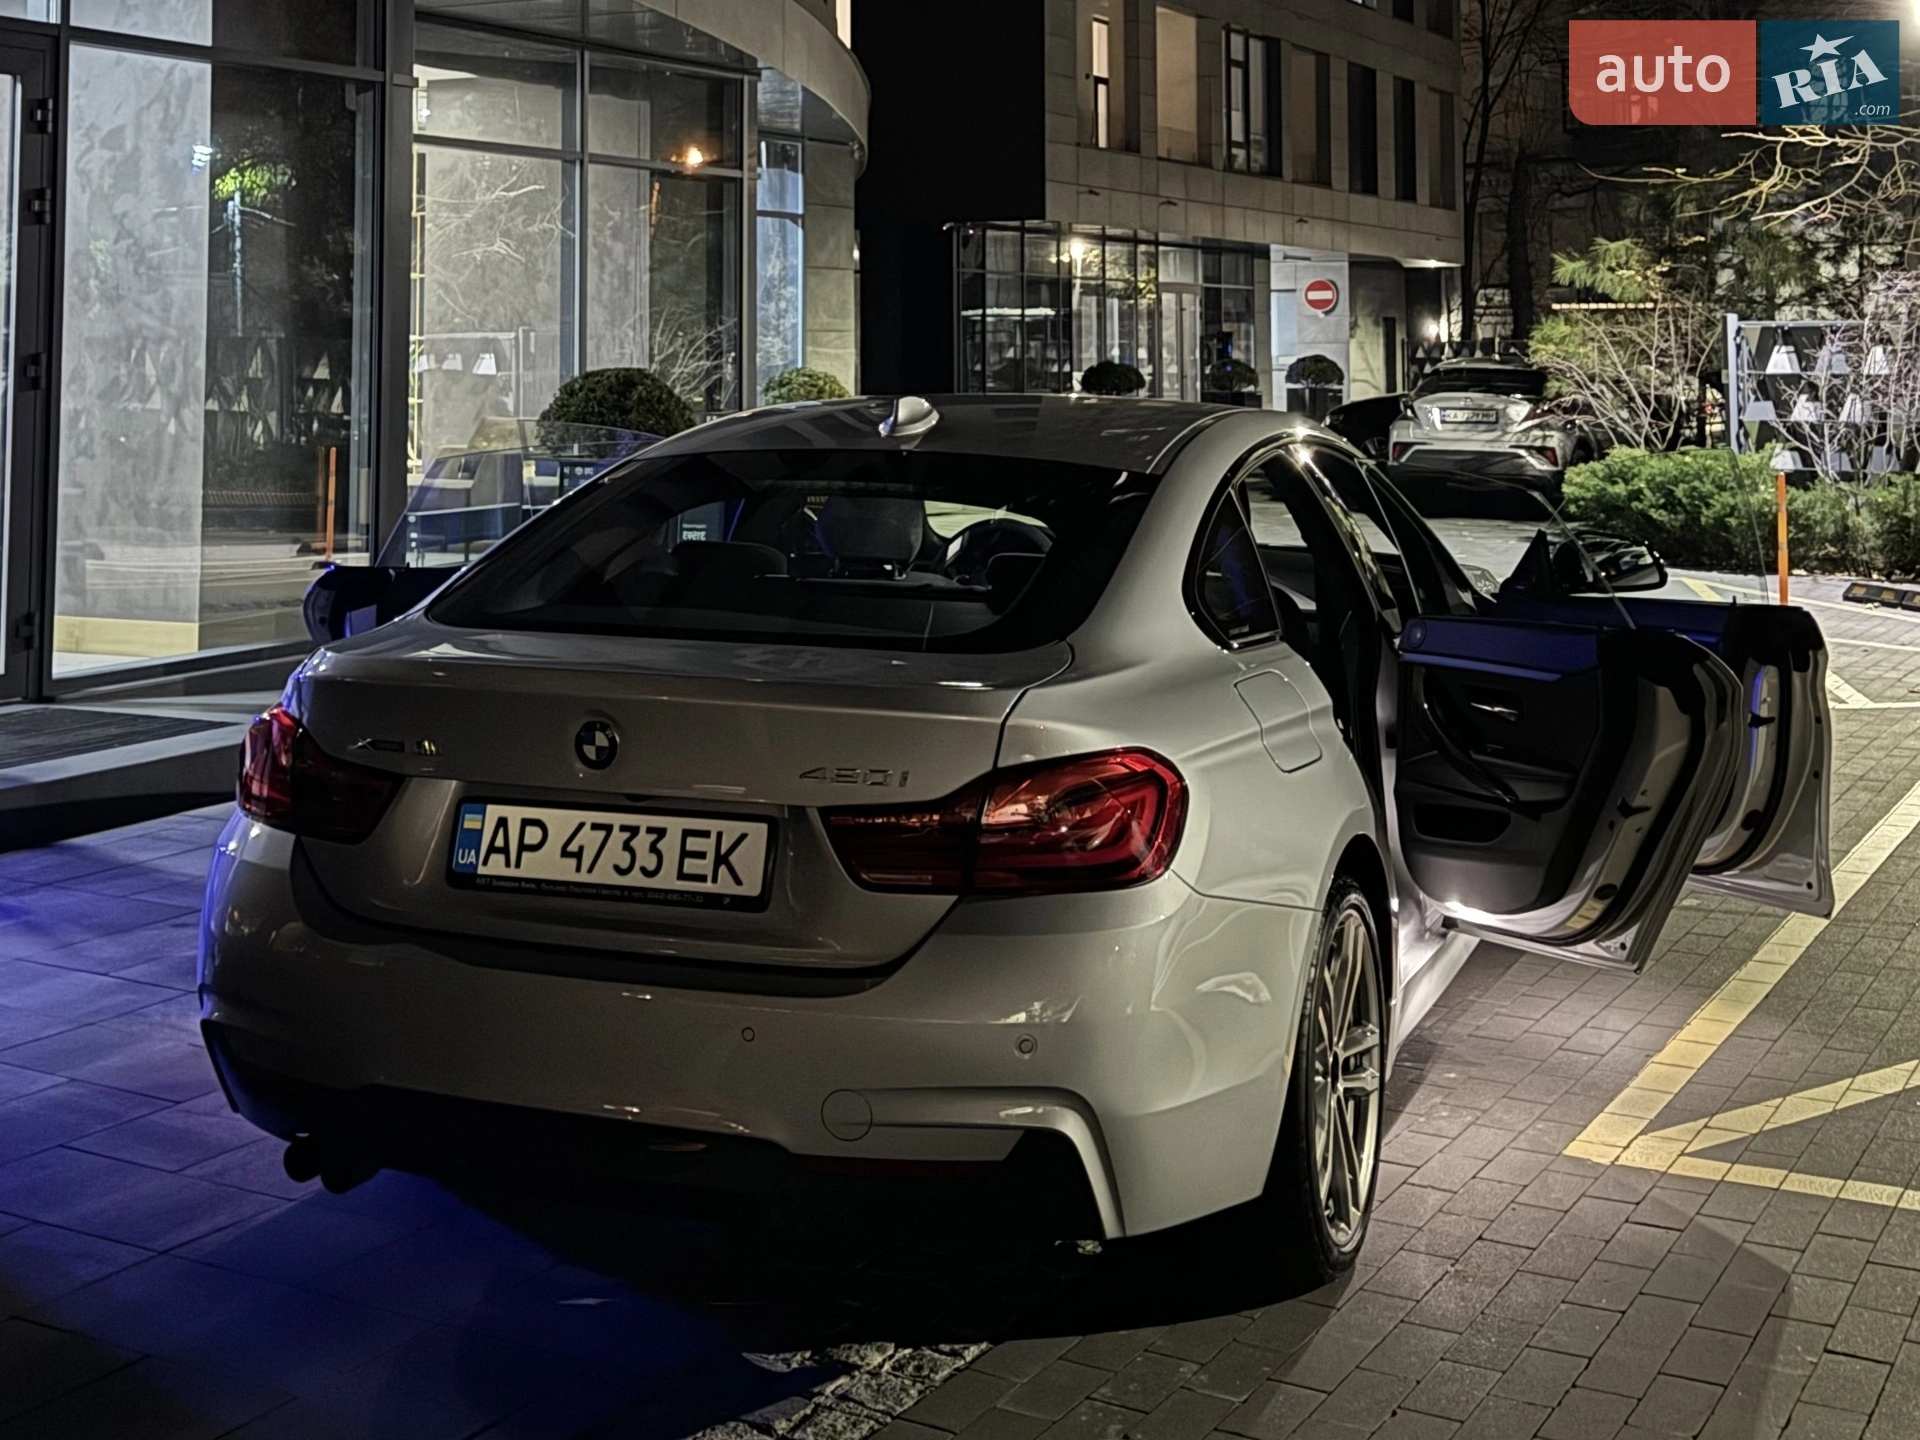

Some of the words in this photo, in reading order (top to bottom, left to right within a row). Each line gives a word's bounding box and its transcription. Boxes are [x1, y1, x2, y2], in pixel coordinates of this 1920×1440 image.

[457, 848, 477, 865] UA
[481, 816, 549, 870] AP
[559, 821, 668, 879] 4733
[676, 828, 750, 887] EK
